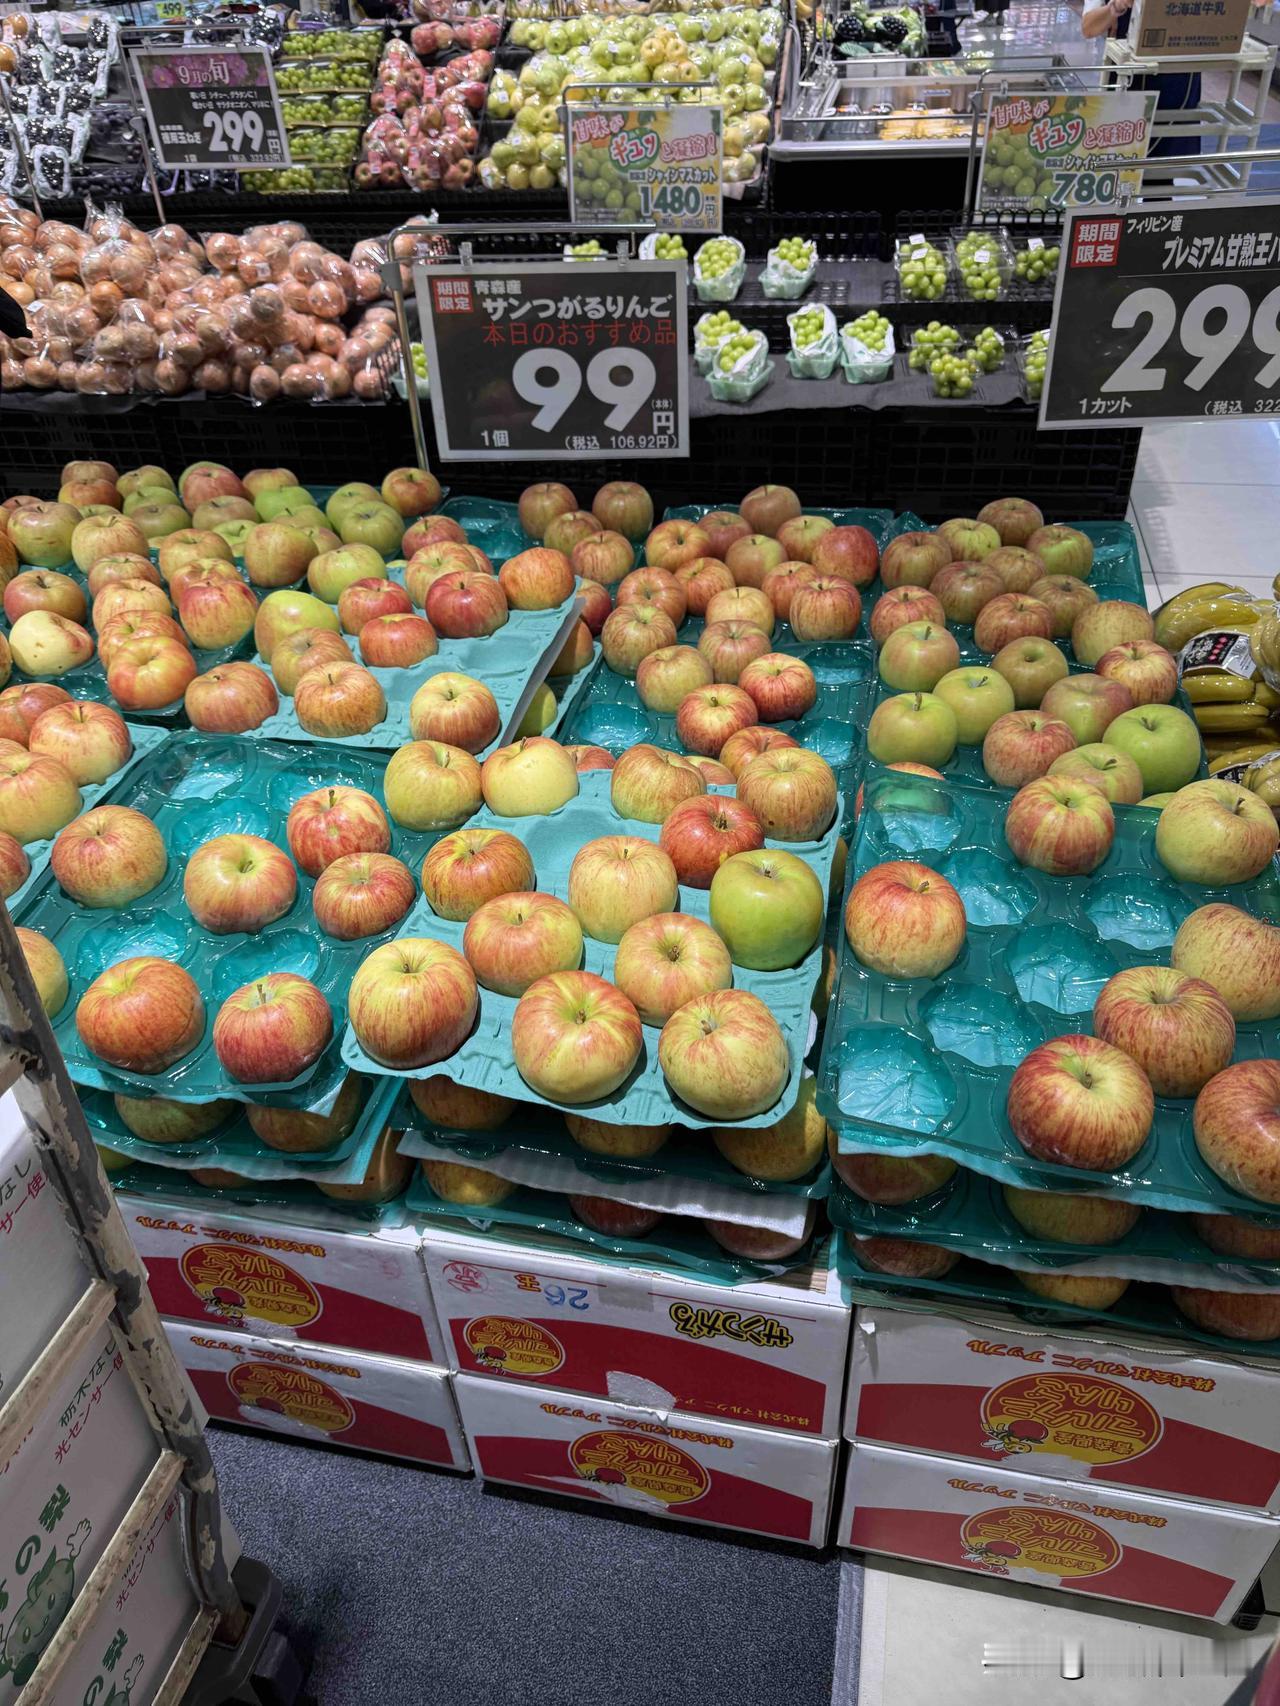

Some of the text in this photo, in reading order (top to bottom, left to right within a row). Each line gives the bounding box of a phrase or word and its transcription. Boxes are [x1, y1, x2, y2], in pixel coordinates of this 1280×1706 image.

[1166, 1, 1226, 16] 北海道牛乳
[178, 58, 229, 84] 9月の旬
[991, 99, 1050, 130] 甘味が
[203, 110, 264, 152] 299
[575, 113, 625, 143] 甘味が
[639, 185, 703, 216] 1480
[1051, 171, 1118, 206] 780
[1078, 222, 1120, 242] 期間
[1127, 215, 1183, 234] フィリピン産
[1075, 244, 1114, 263] 限定
[437, 280, 469, 296] 期間
[475, 279, 522, 295] 青森産
[439, 298, 471, 311] 限定
[482, 294, 673, 321] サンつがるりんご
[482, 319, 676, 347] 本日のおすすめ品
[512, 347, 656, 433] 99
[1079, 396, 1132, 414] 1カット
[652, 411, 675, 435] 円
[481, 430, 510, 447] 1個
[670, 1303, 794, 1348] サンつがる
[966, 1339, 1046, 1363] アップル
[1023, 1378, 1134, 1413] りんご
[999, 1398, 1146, 1438] マルクニ
[597, 1434, 681, 1464] りんご
[1053, 1431, 1134, 1455] 青森県産
[998, 1509, 1097, 1540] りんご
